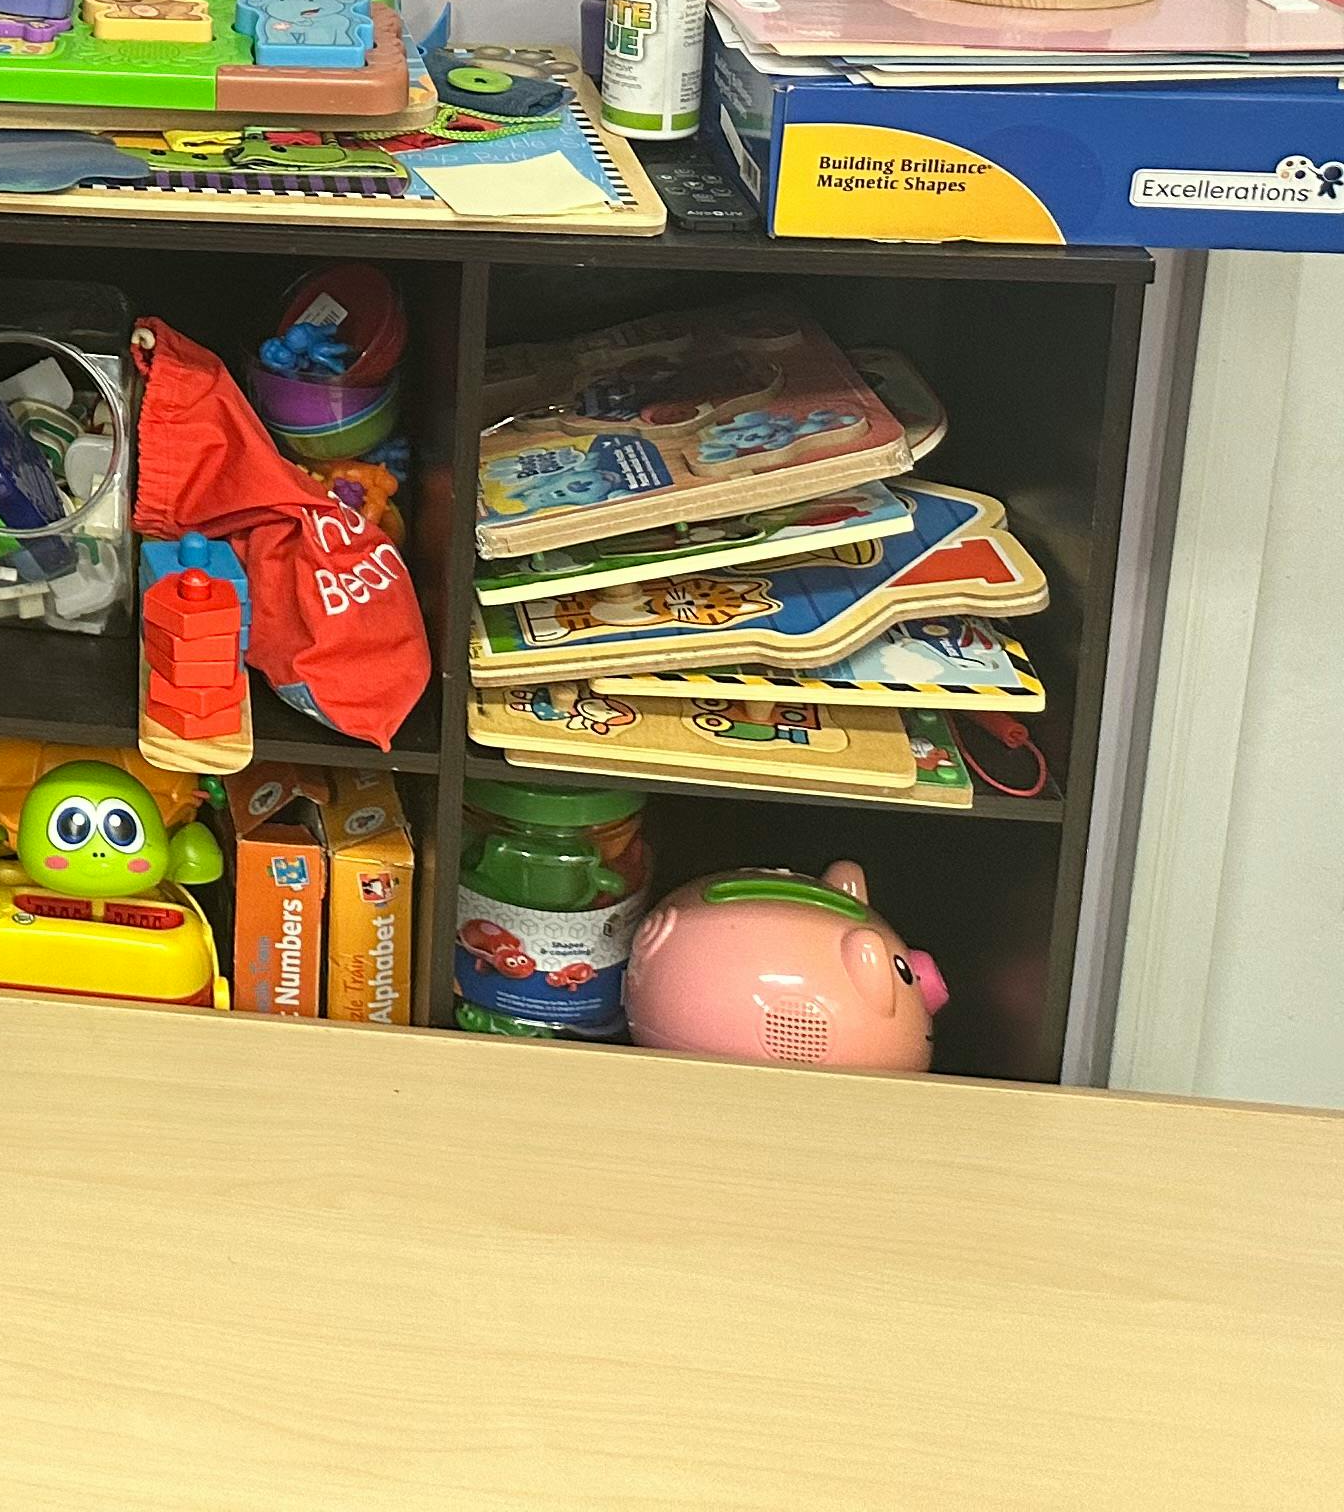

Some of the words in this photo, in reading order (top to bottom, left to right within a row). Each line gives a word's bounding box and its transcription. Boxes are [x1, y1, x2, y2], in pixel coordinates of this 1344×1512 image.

[816, 174, 899, 193] Magnetic
[903, 176, 966, 194] Shapes
[818, 156, 895, 175] Building
[899, 157, 989, 177] Brilliance
[1142, 178, 1311, 204] Excellerations
[314, 543, 407, 616] Bean
[274, 897, 303, 1006] Numbers
[368, 913, 395, 1023] Alphabet
[349, 953, 363, 994] Train
